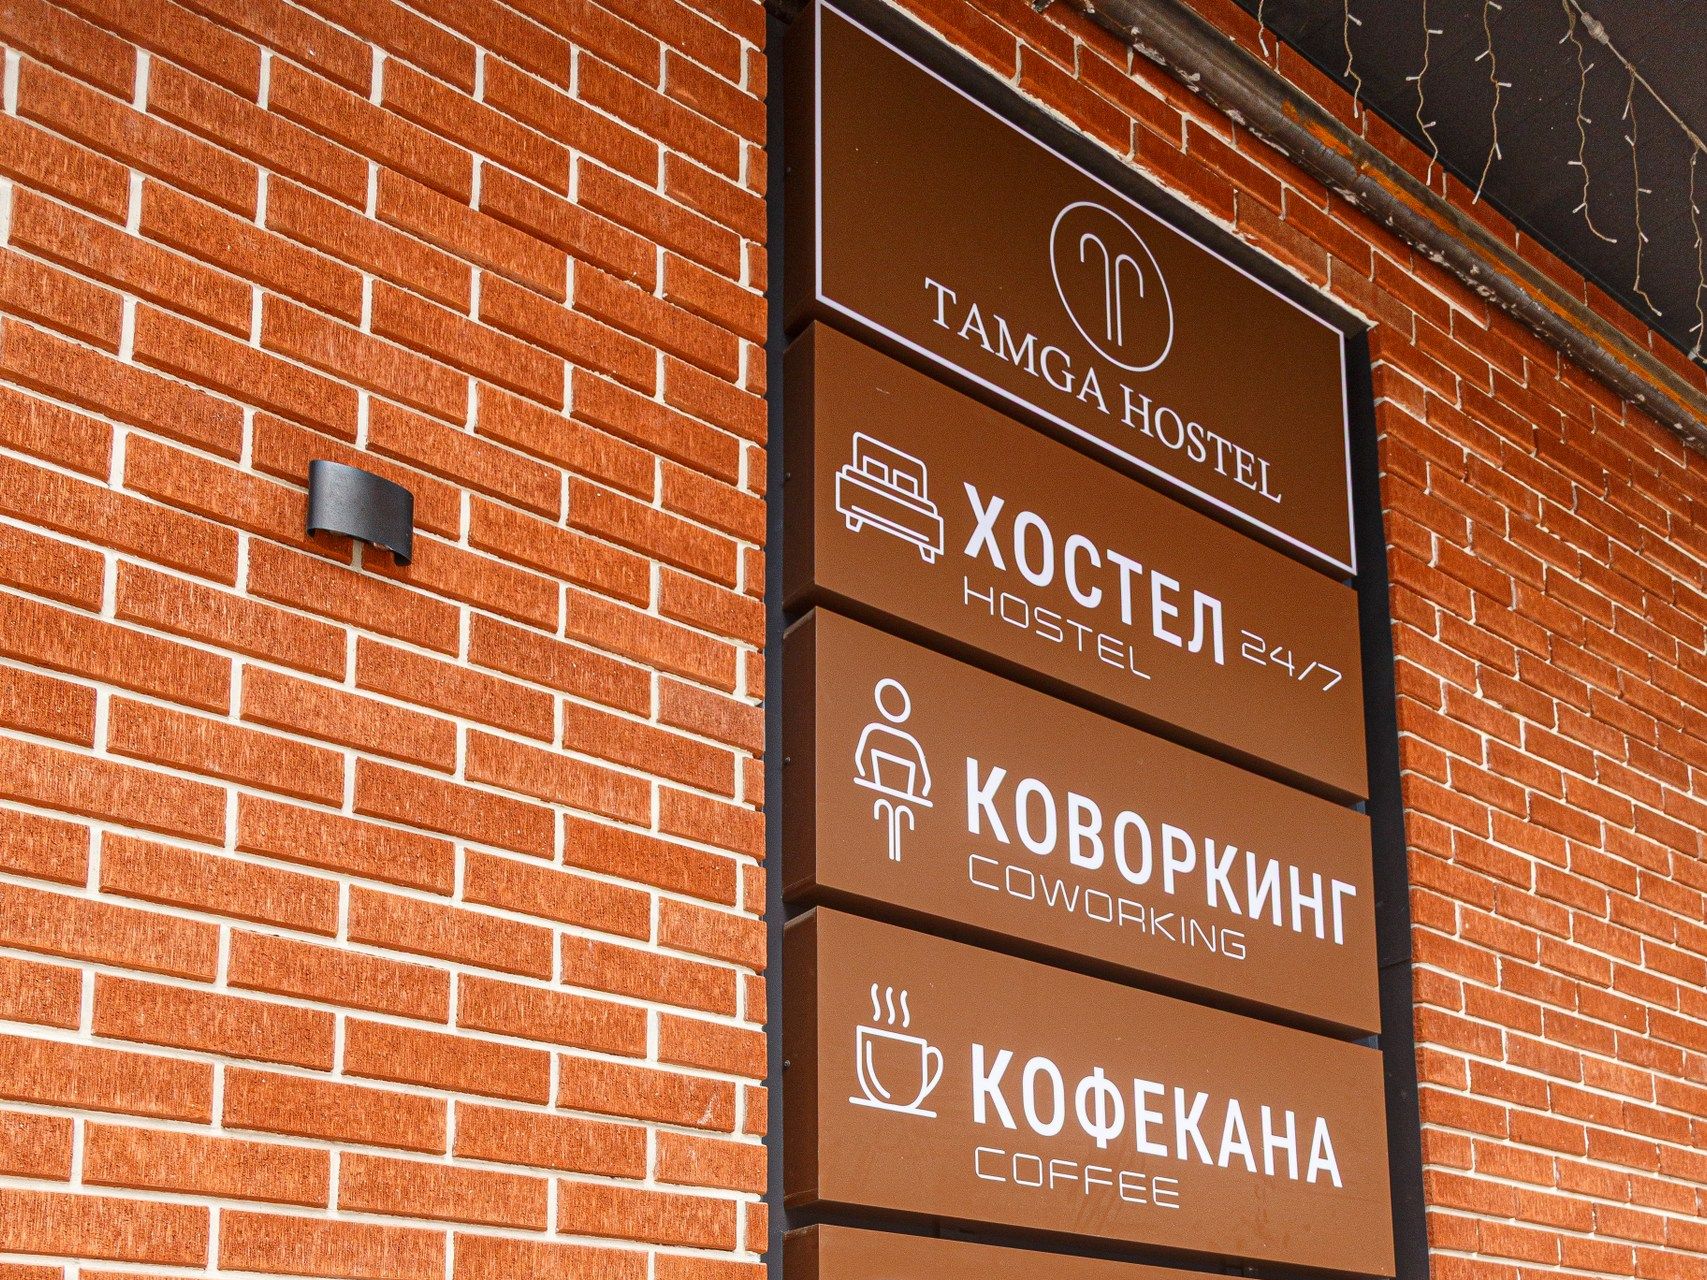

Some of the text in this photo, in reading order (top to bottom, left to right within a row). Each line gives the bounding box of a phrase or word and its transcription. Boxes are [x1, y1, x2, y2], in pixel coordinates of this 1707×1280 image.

[924, 277, 1282, 503] TAMGA HOSTEL
[963, 482, 1343, 692] ХОСТЕЛ 24/7
[964, 576, 1151, 680] HOSTEL
[966, 756, 1357, 945] КОВОРКИНГ
[968, 853, 1246, 960] COWORKING
[971, 1043, 1343, 1188] КОФЕКАНА
[975, 1146, 1180, 1209] COFFEE
